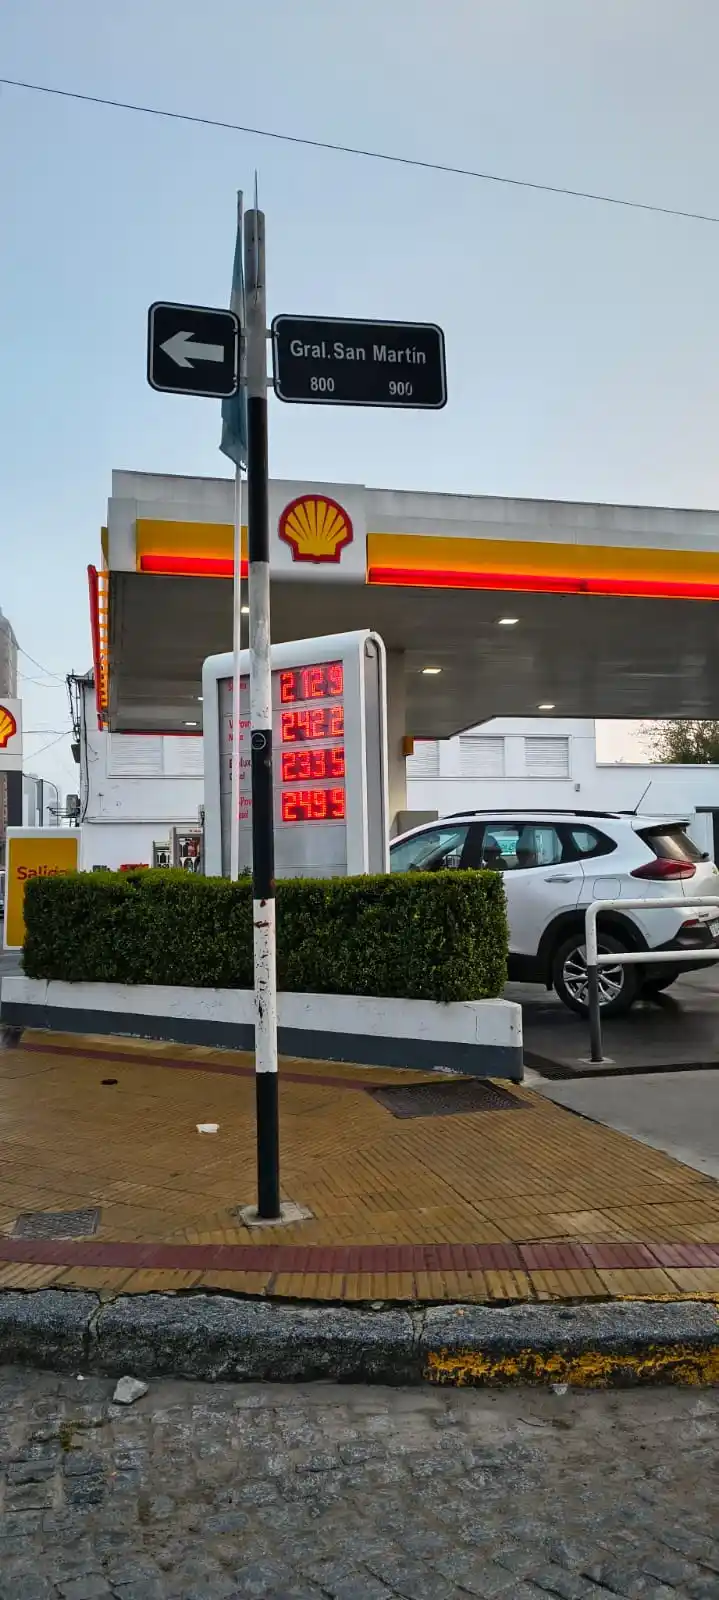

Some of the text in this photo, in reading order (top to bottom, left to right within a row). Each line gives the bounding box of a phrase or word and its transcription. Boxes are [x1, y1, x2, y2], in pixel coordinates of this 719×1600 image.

[310, 376, 335, 392] 800
[388, 380, 413, 396] 900
[281, 664, 344, 701] 2129
[282, 706, 345, 741] 2422
